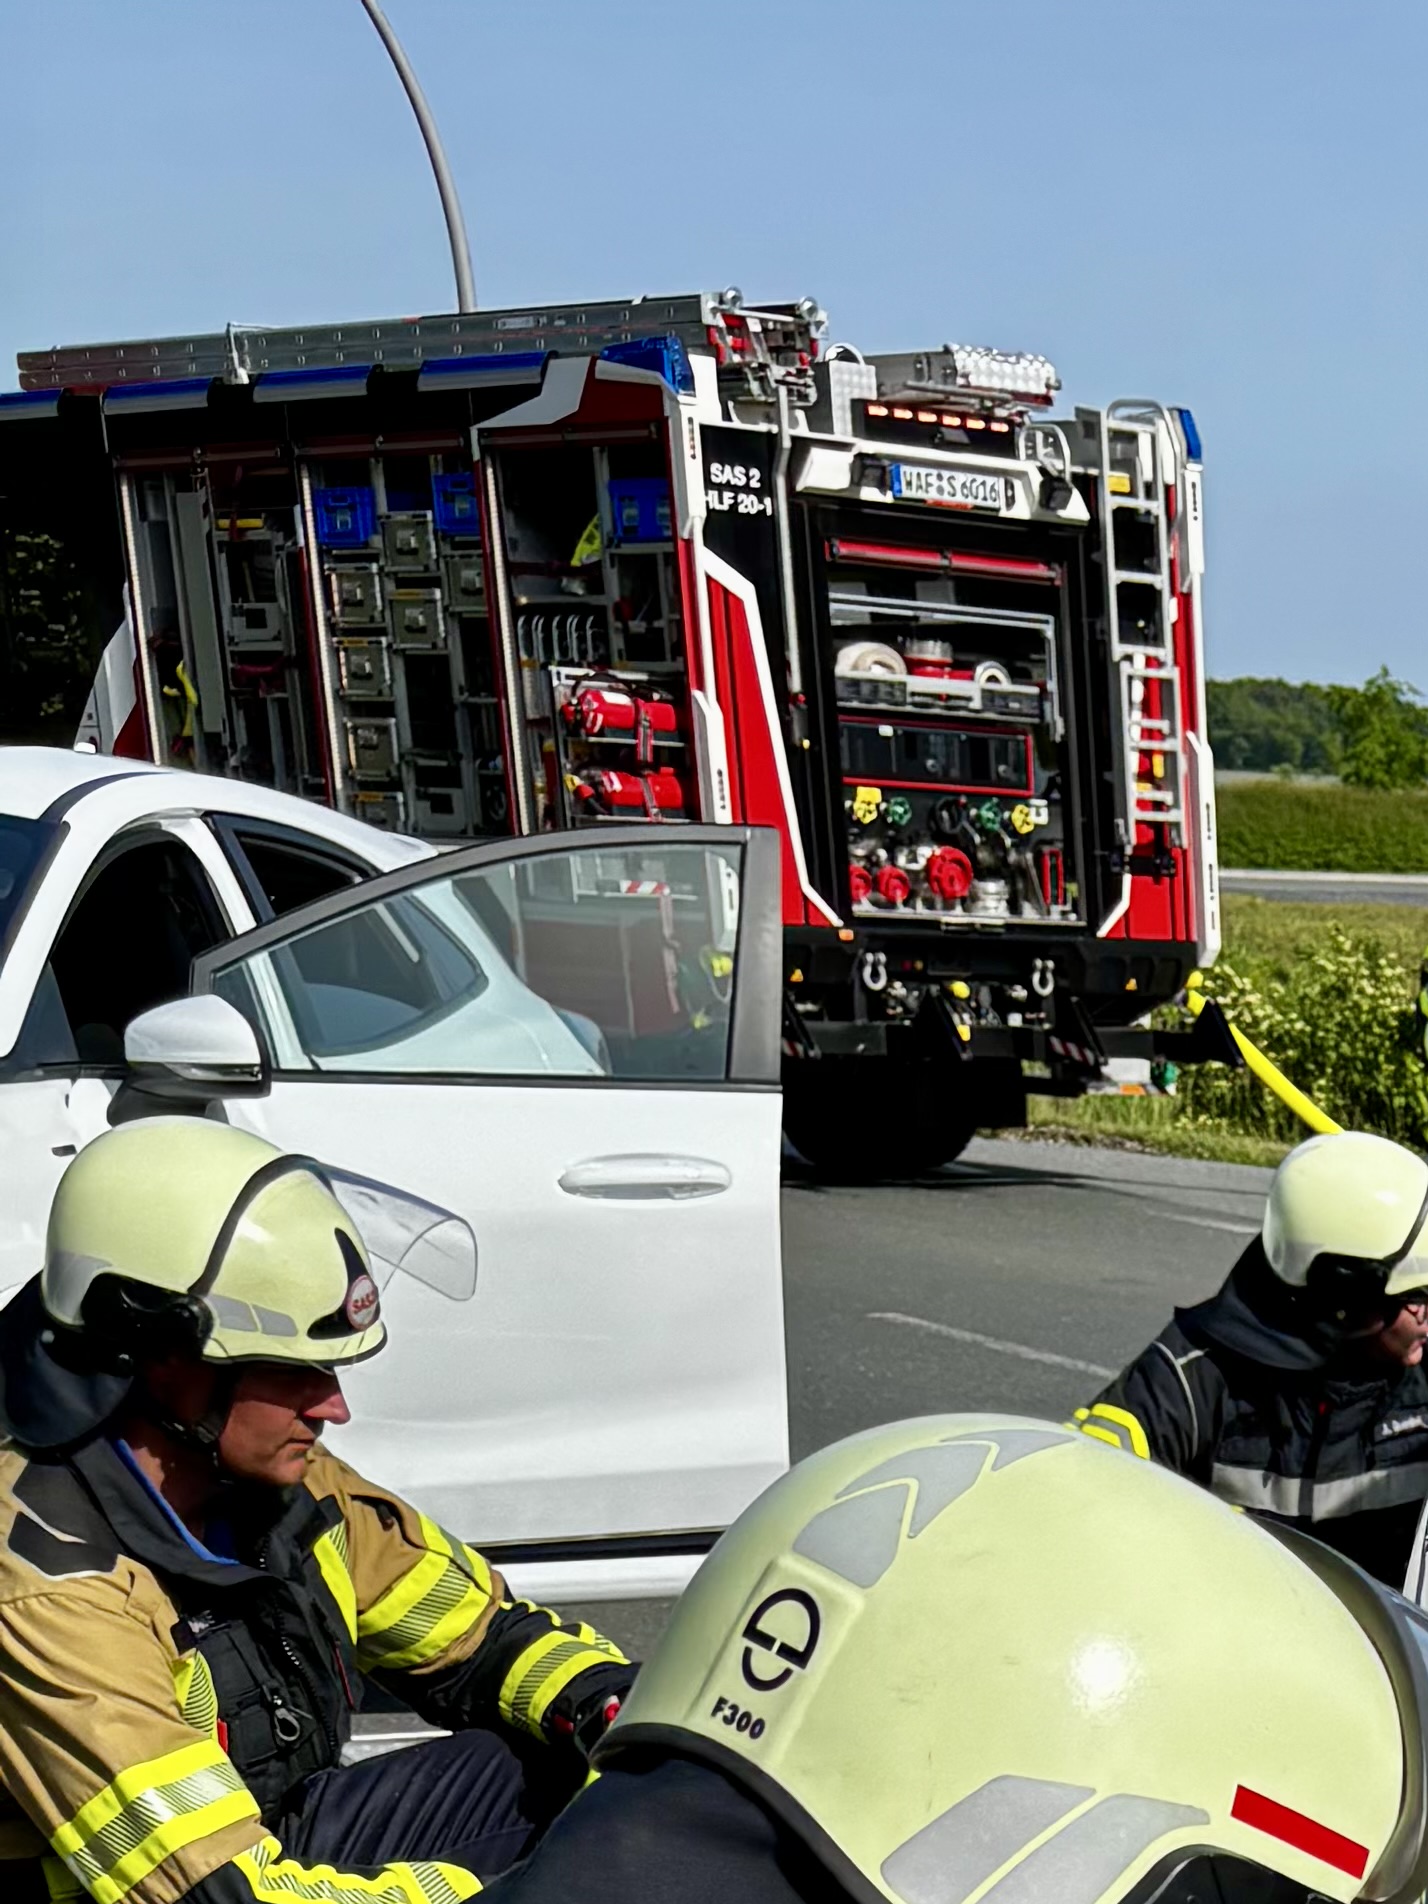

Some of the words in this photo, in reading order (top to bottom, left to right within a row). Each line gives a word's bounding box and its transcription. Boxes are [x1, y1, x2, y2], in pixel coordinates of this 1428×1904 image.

[709, 462, 747, 487] SAS
[749, 467, 762, 488] 2
[903, 470, 934, 494] WAF
[946, 475, 957, 497] S
[705, 489, 736, 511] HLF
[737, 492, 773, 516] 20-1
[711, 1696, 766, 1740] F300
